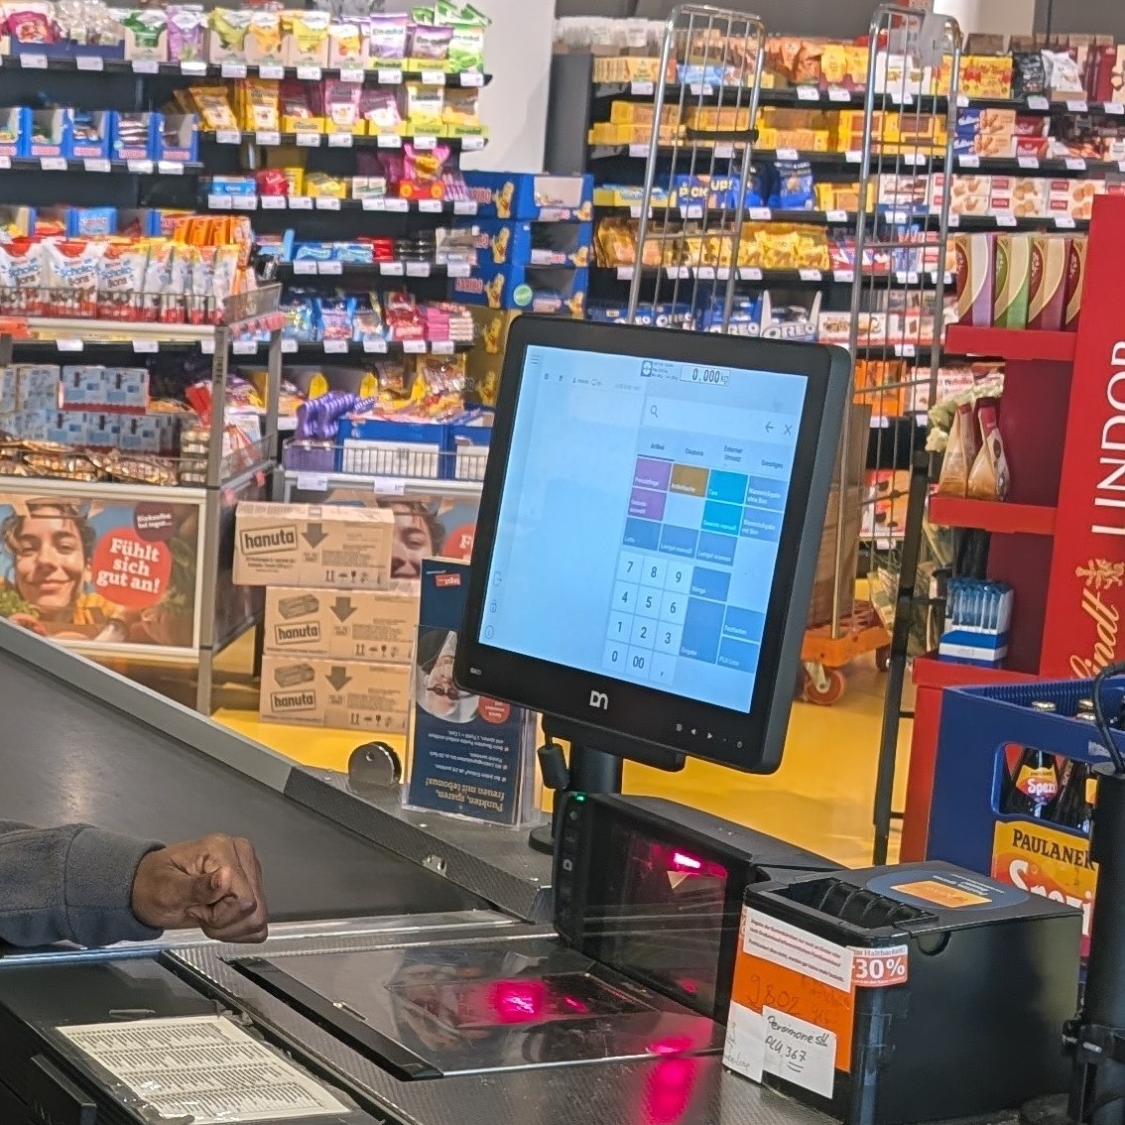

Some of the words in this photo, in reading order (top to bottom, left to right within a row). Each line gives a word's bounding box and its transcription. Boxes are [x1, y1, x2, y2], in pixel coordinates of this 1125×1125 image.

[244, 530, 295, 549] hanuta
[110, 538, 159, 562] Fühlt
[113, 556, 150, 576] sich
[627, 561, 634, 573] 7
[651, 566, 657, 578] 8
[676, 571, 682, 583] 9
[96, 570, 128, 587] gut
[130, 577, 160, 594] an!
[622, 591, 628, 603] 4
[646, 596, 652, 608] 5
[670, 602, 676, 613] 6
[278, 625, 318, 641] hanuta
[640, 627, 647, 639] 2
[665, 632, 671, 644] 3
[633, 656, 644, 669] 00
[274, 693, 314, 708] hanuta
[466, 796, 503, 812] Punkten,
[1012, 829, 1095, 871] PAULANER
